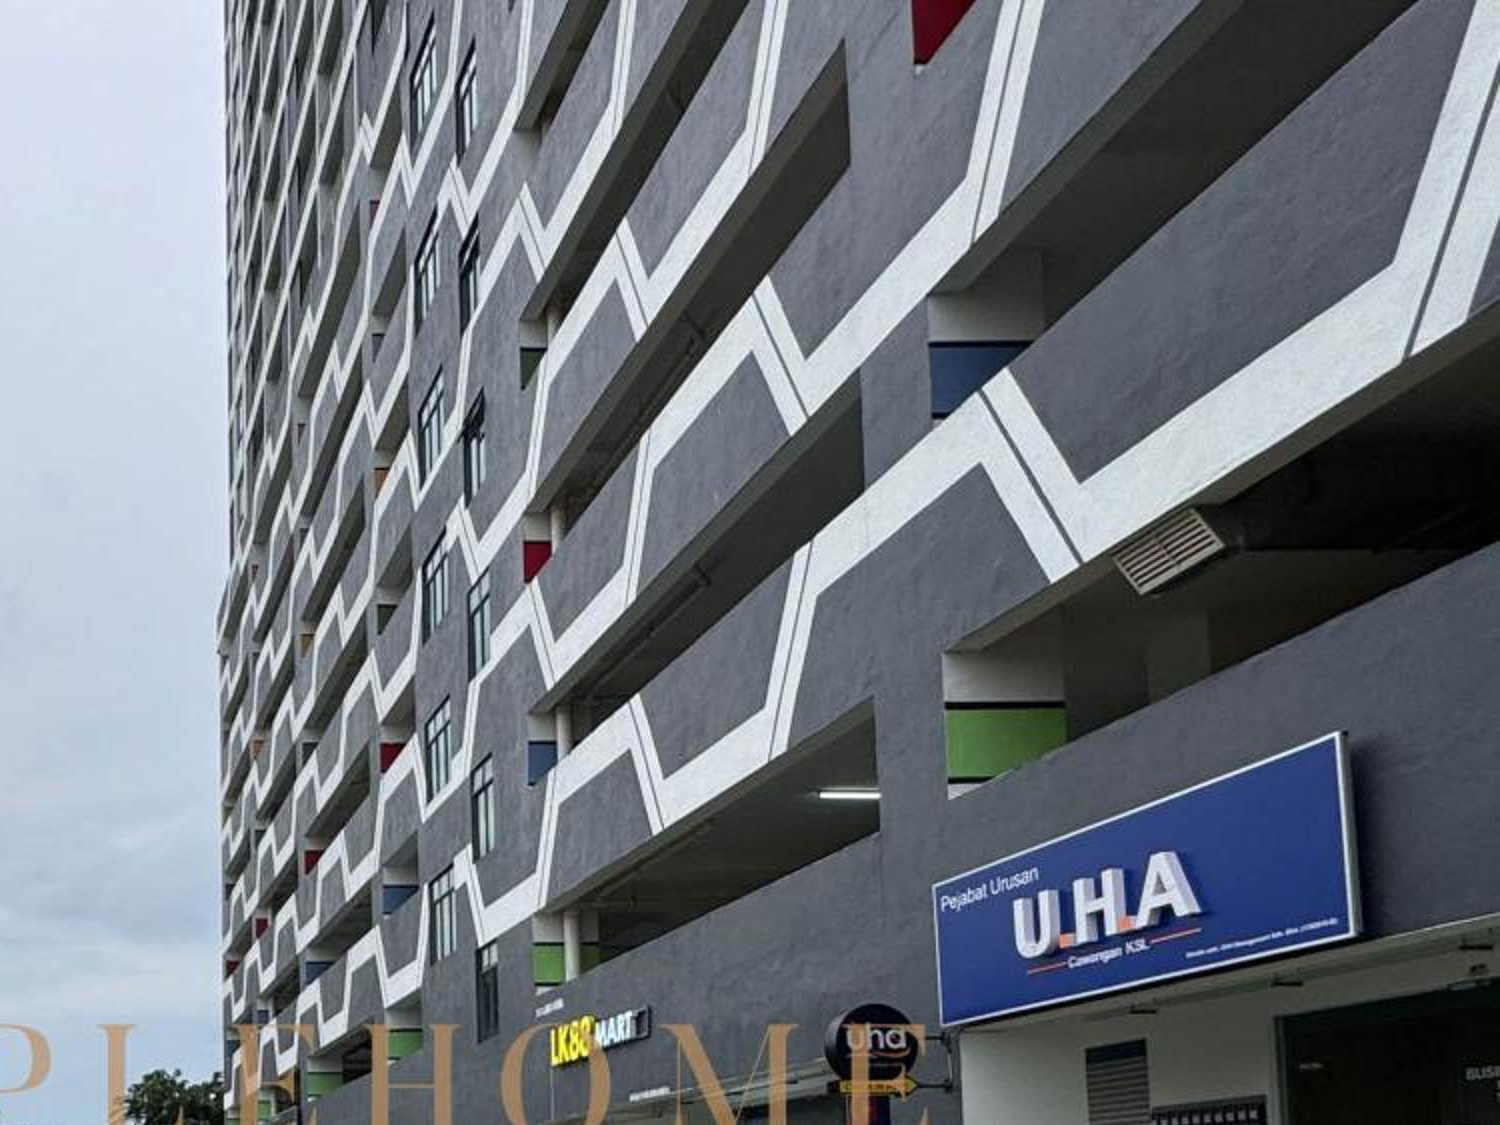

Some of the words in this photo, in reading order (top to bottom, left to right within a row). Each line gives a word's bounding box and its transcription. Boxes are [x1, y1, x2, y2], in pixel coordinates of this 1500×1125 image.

[941, 883, 988, 912] Pejabat
[990, 867, 1039, 895] Urusan
[1125, 938, 1150, 954] KSL
[550, 1014, 595, 1067] LK88
[595, 1010, 634, 1049] MART
